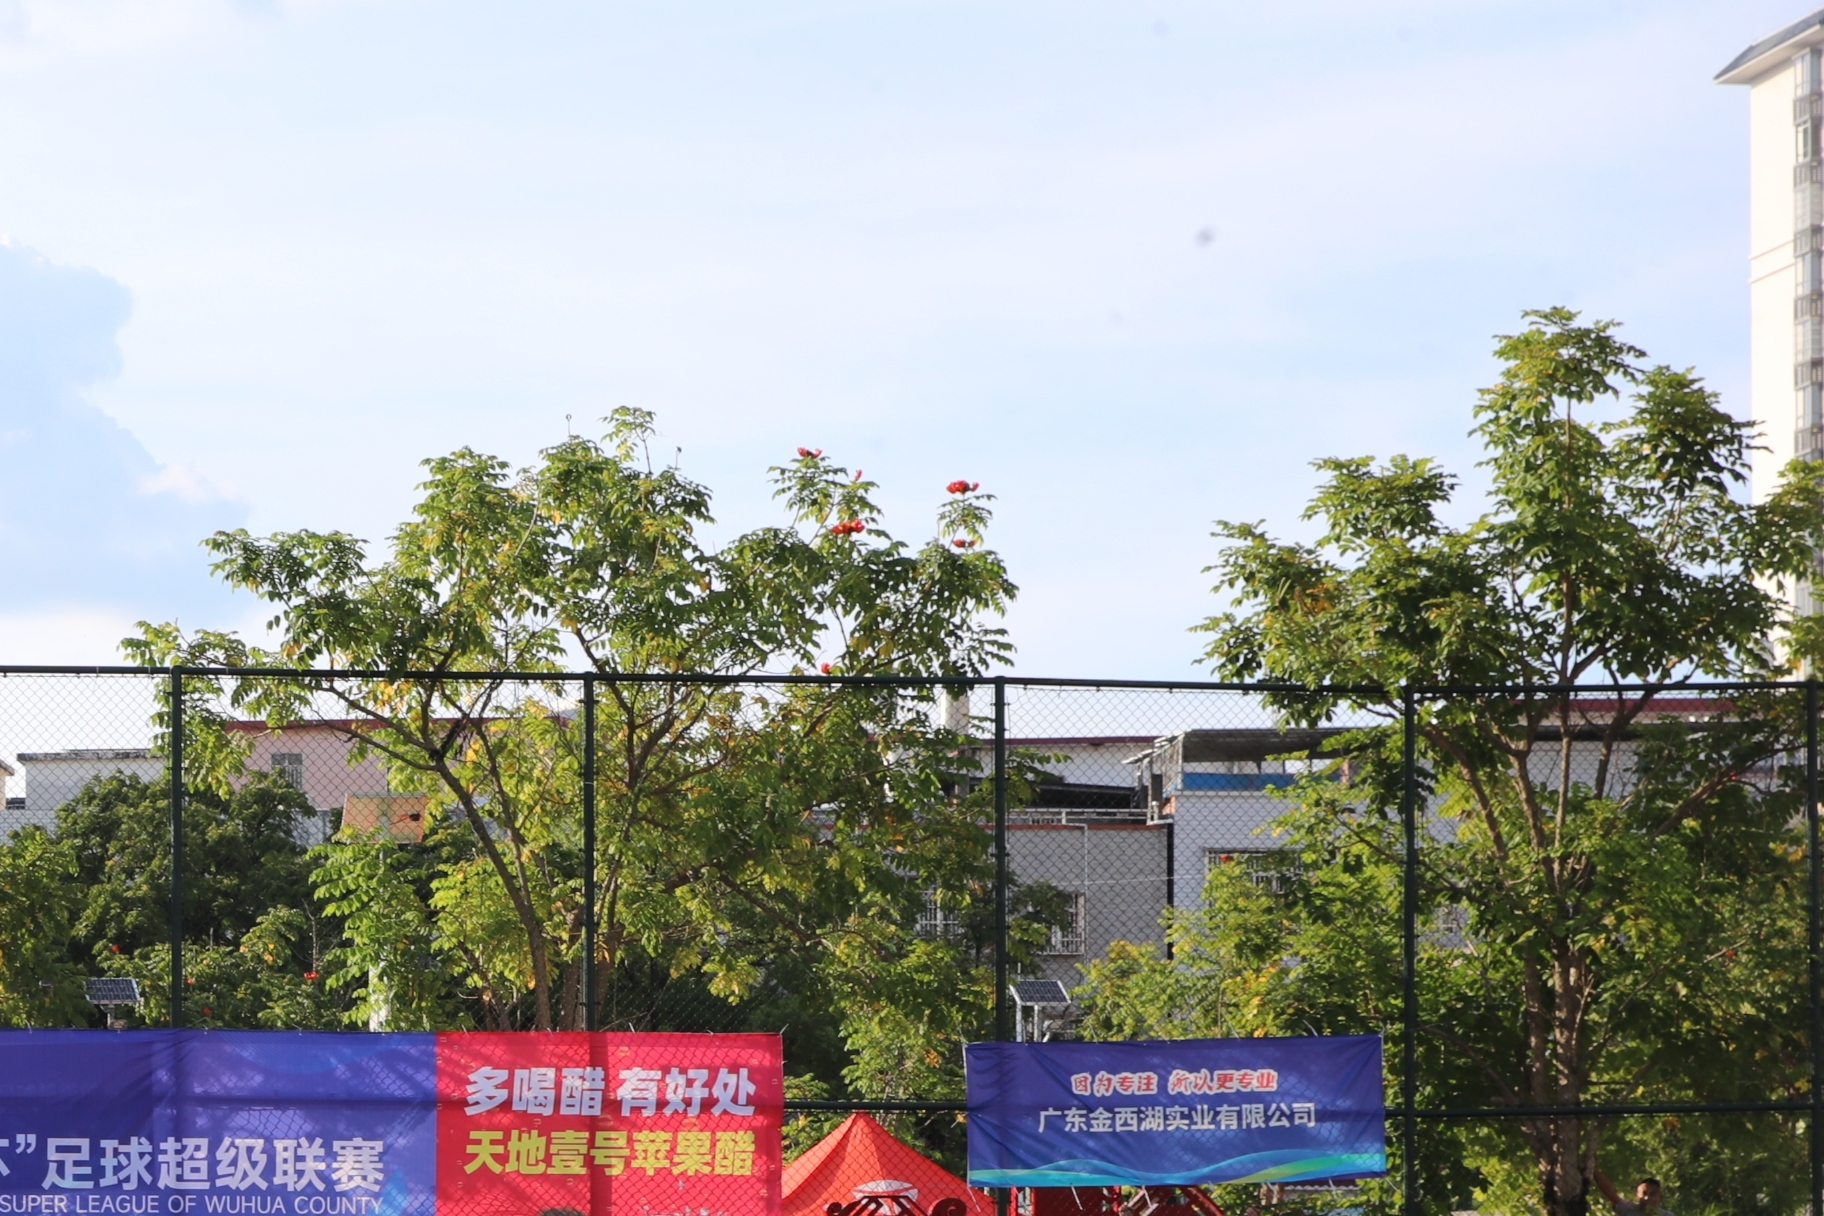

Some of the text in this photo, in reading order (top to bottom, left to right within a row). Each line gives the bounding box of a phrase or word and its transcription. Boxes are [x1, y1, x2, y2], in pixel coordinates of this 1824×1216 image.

[464, 1067, 757, 1117] 多喝醋 有好处
[1071, 1068, 1279, 1097] 因为专注 所以更专业
[1038, 1101, 1317, 1133] 广东金西湖实业有限公司
[463, 1130, 755, 1176] 天地壹号苹果醋
[0, 1195, 68, 1214] SUPER
[76, 1195, 159, 1214] LEAGUE
[167, 1195, 197, 1214] OF
[206, 1195, 286, 1215] WUHUA
[294, 1196, 383, 1215] COUNTY
